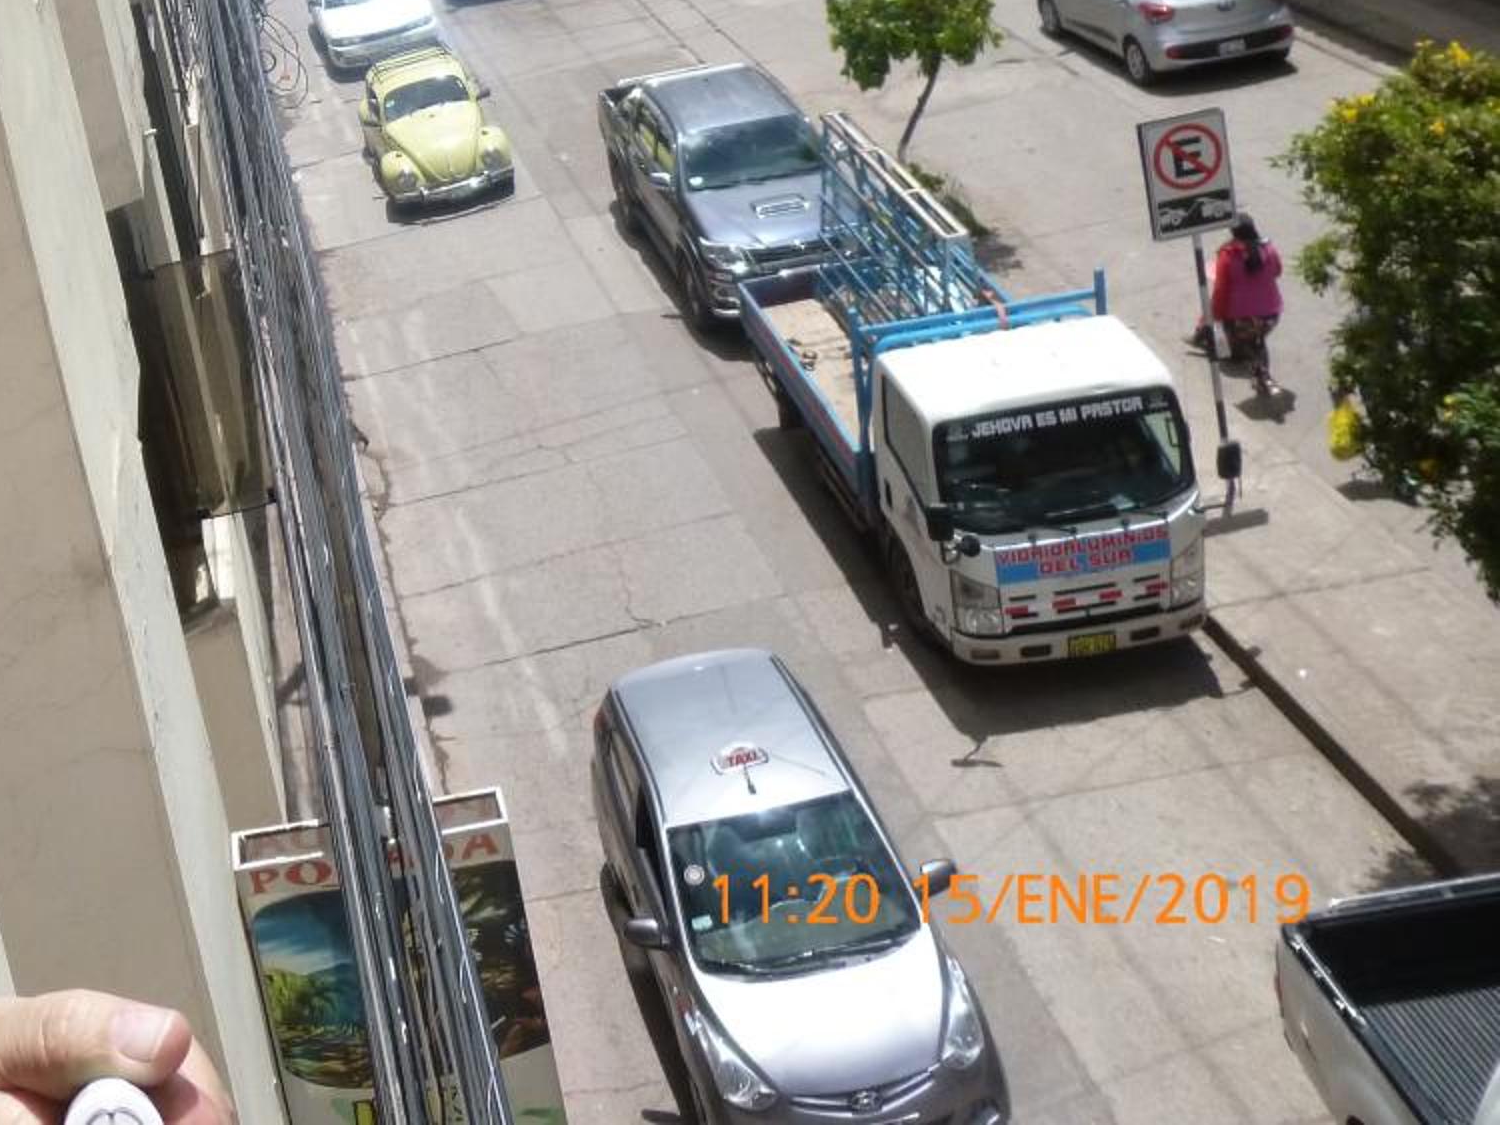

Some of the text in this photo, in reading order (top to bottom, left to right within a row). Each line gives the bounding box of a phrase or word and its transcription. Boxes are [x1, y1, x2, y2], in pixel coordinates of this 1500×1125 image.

[1173, 135, 1207, 178] E
[972, 395, 1143, 438] JEHOVA ES MI PASTOR
[1040, 547, 1132, 574] DEL SUR
[726, 749, 758, 768] TAXI
